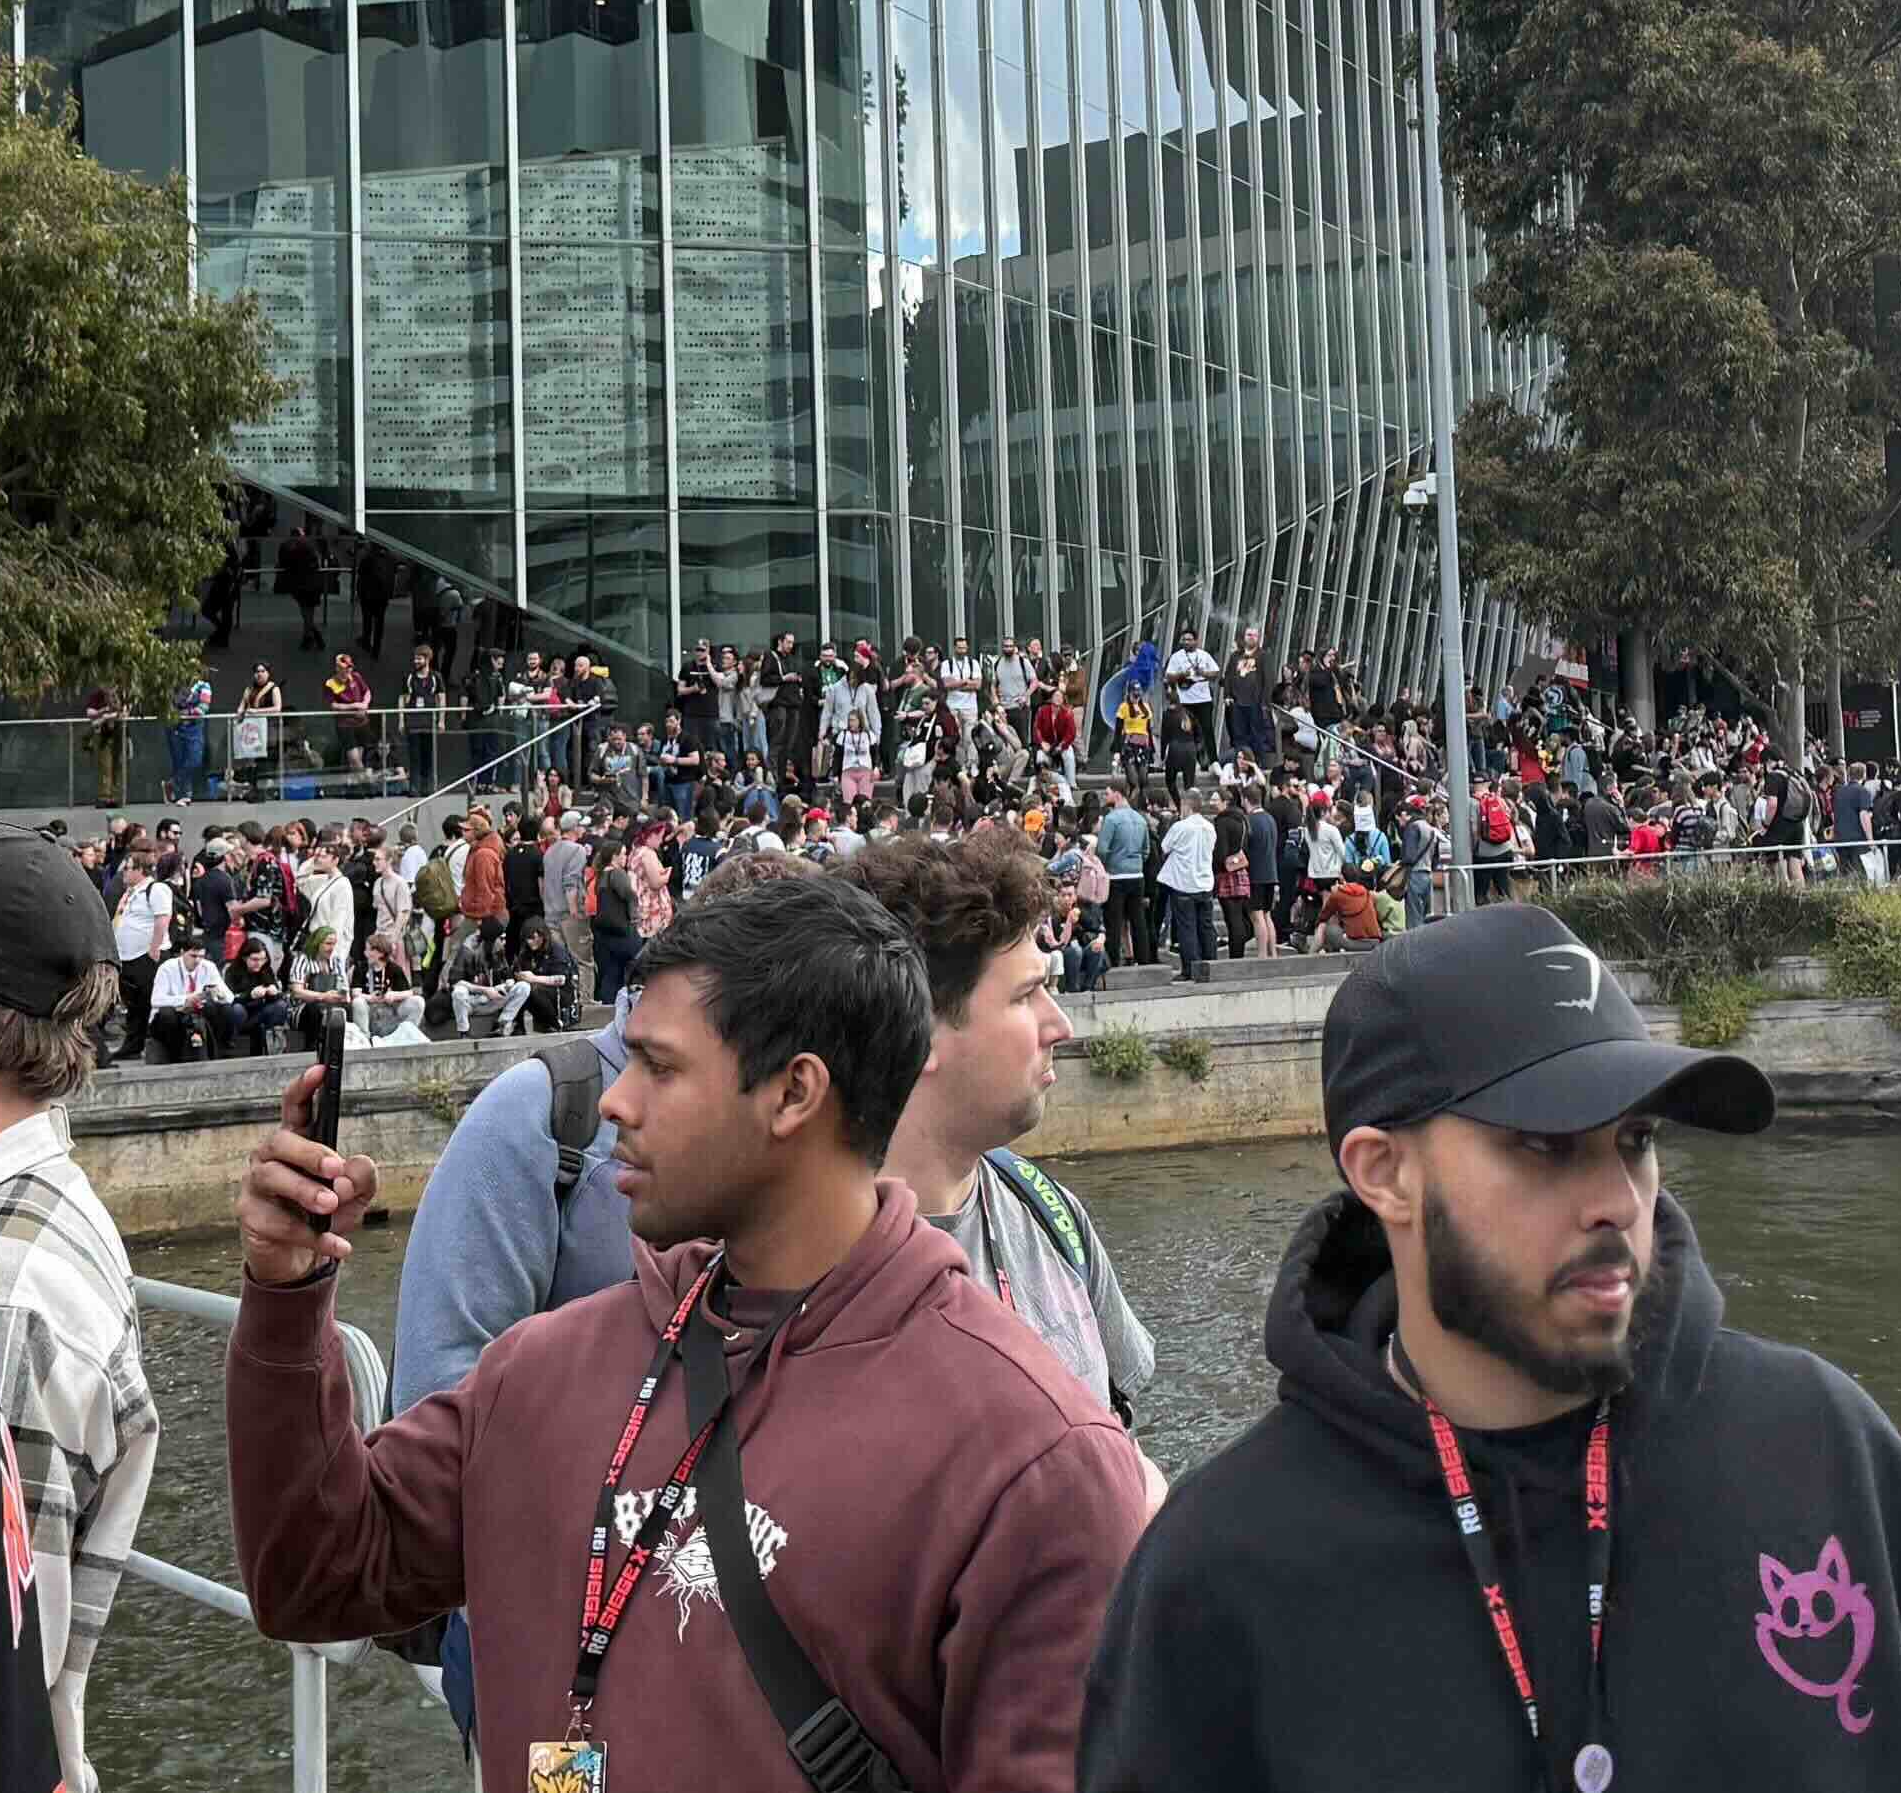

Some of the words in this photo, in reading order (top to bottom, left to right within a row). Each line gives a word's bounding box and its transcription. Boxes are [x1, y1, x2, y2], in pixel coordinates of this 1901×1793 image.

[1457, 1502, 1482, 1535] R6
[587, 1632, 609, 1654] R6
[599, 1564, 640, 1630] SIEGE
